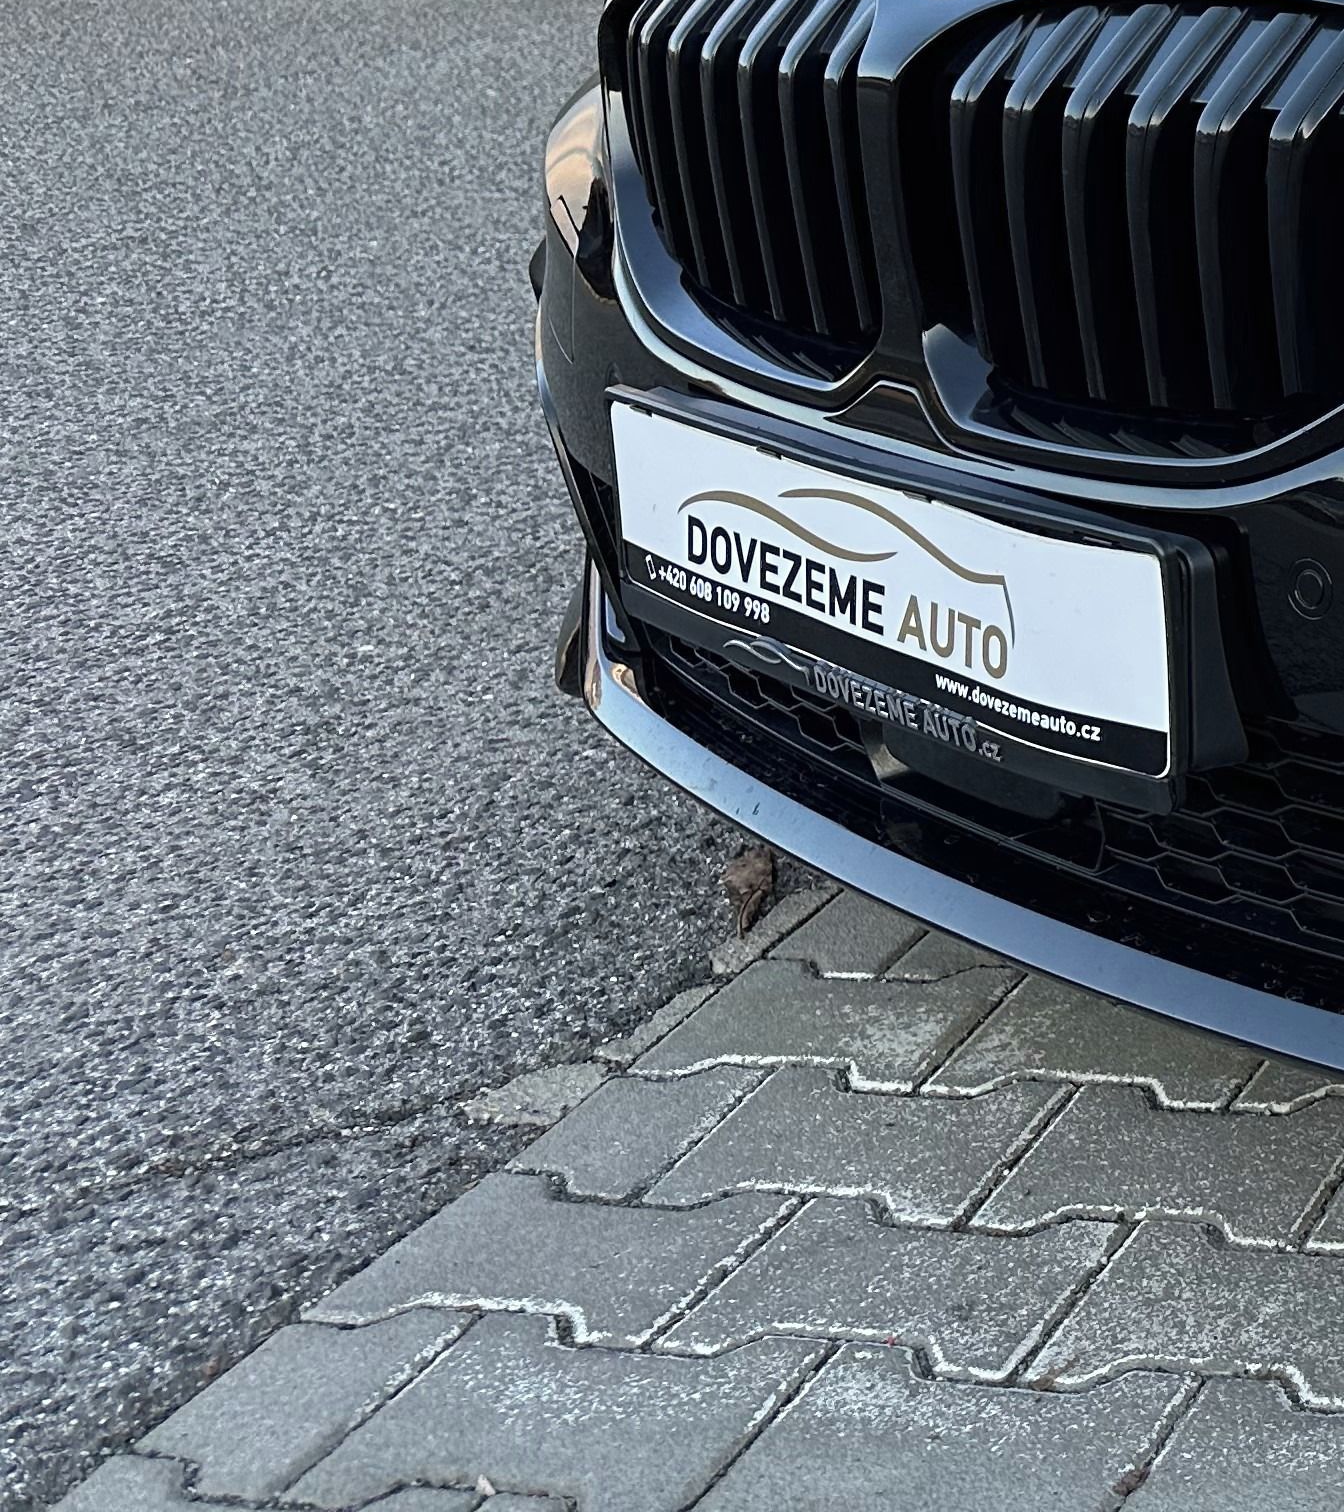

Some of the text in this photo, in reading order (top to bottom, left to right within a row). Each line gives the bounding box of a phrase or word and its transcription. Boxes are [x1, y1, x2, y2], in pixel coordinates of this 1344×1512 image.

[658, 563, 771, 624] +420 608 109 998
[687, 515, 1008, 679] DOVEZEME AUTO
[813, 661, 919, 730] DOVEZEME
[935, 673, 1101, 742] www.dovezemeauto.cz
